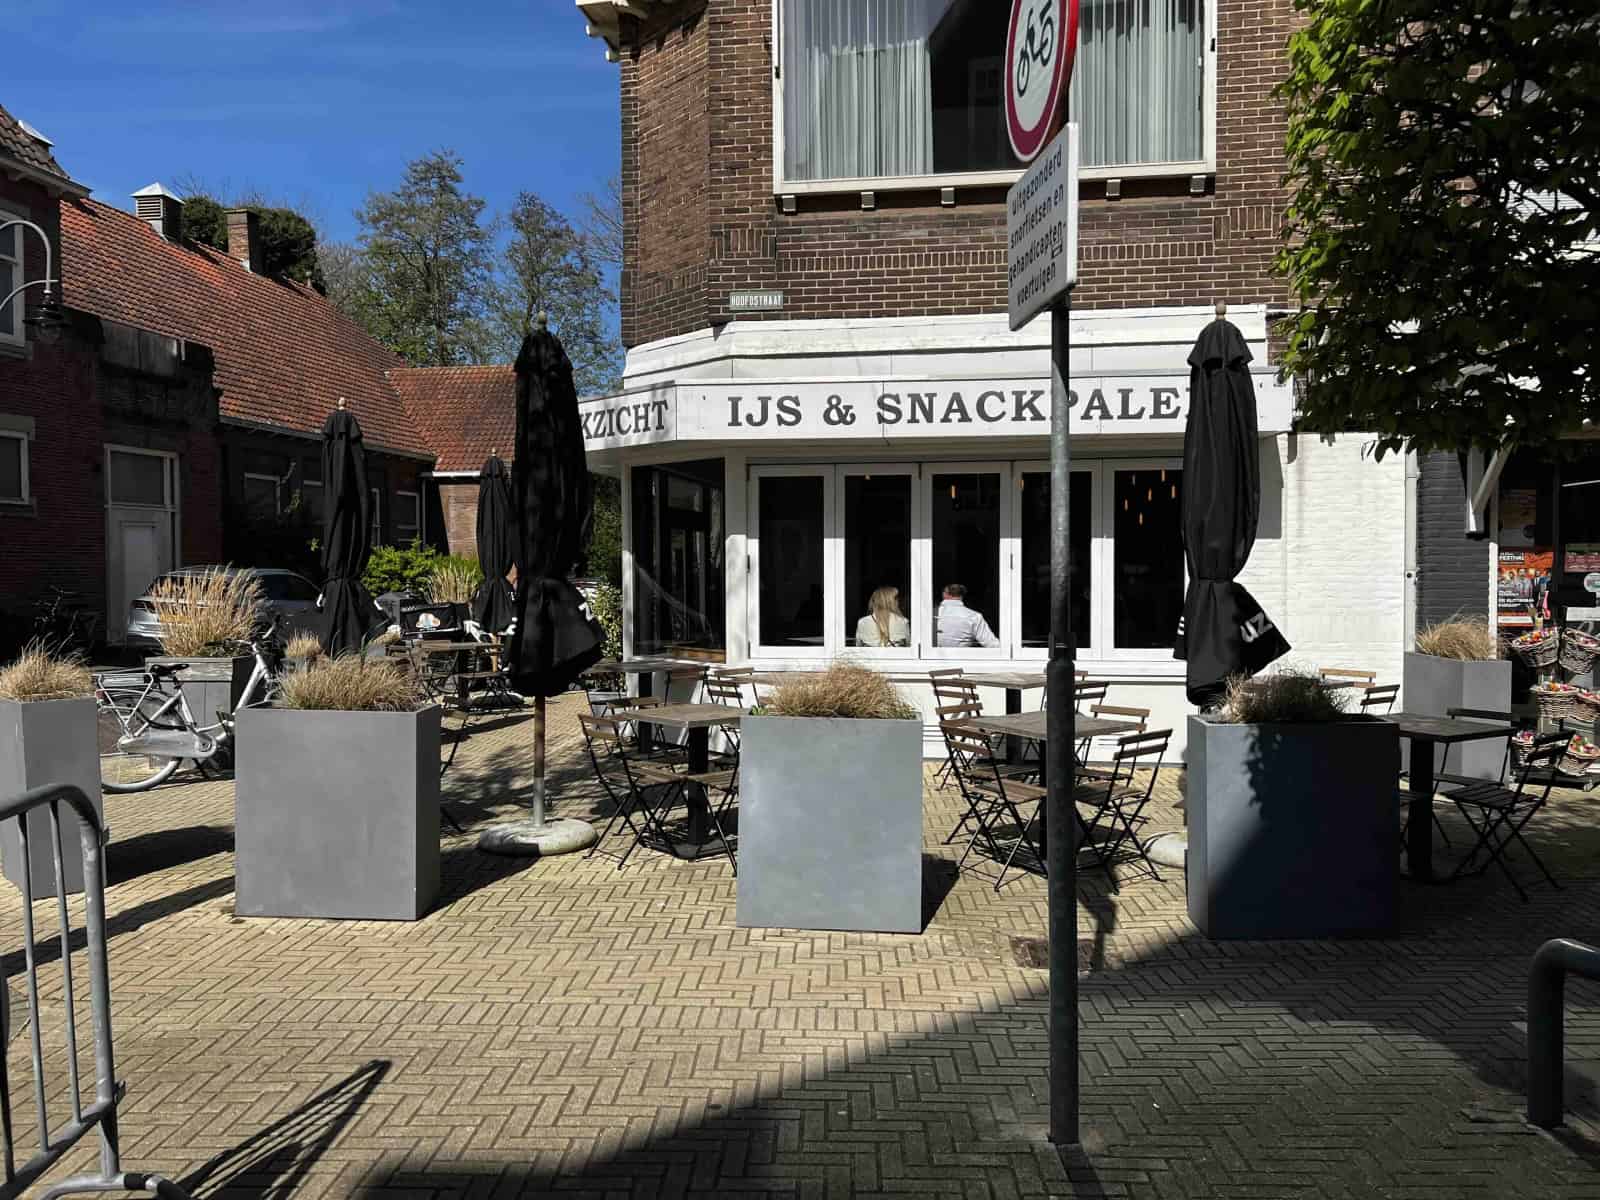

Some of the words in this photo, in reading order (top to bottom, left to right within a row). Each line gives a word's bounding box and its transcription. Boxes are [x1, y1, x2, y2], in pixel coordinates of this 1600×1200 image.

[1012, 144, 1062, 216] uitgezonderd
[1010, 196, 1053, 248] snorfietsen
[1053, 183, 1064, 207] en
[731, 295, 782, 306] HOOFDSTRAAT
[1017, 261, 1056, 307] voertuigen
[727, 396, 802, 427] IJS
[823, 394, 856, 426] &
